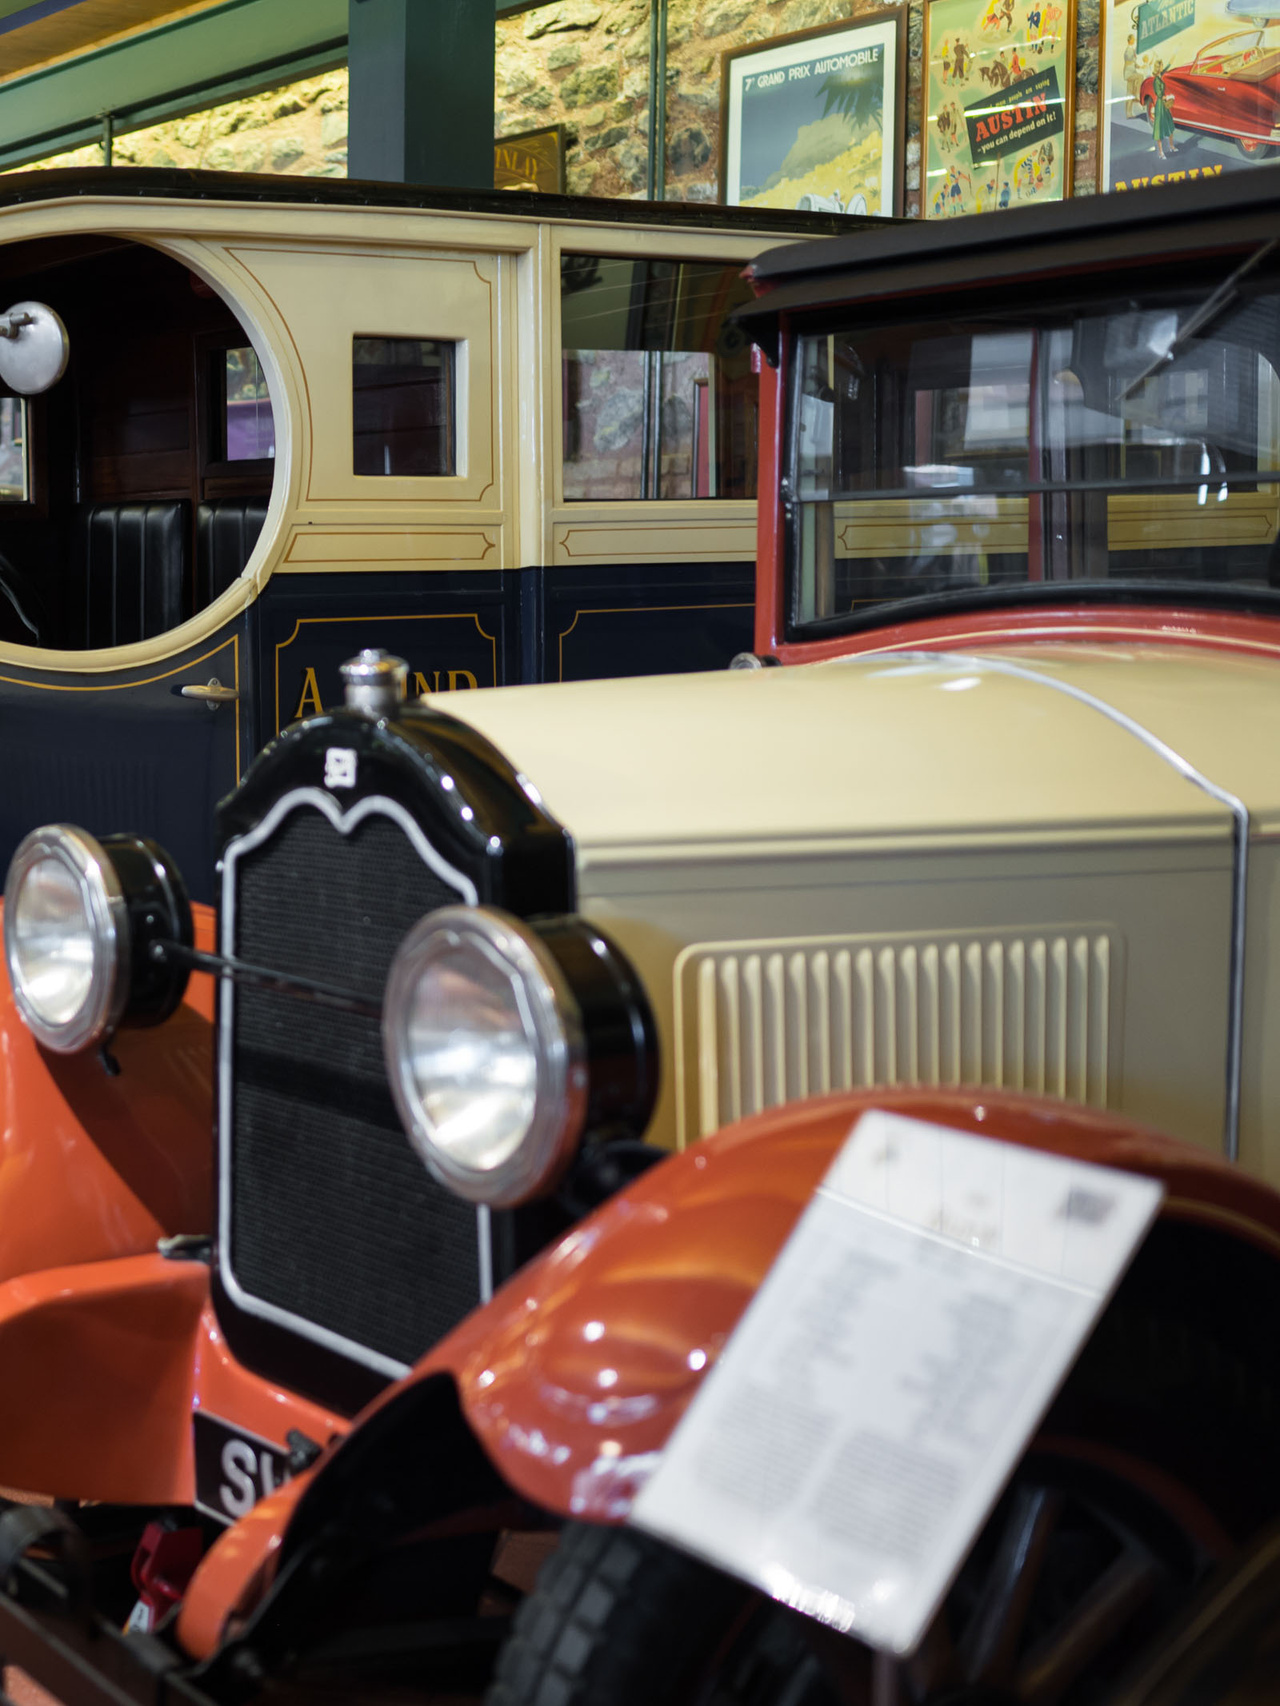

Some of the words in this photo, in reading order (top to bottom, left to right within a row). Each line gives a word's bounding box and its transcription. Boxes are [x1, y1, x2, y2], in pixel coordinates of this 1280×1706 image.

[1140, 0, 1194, 40] ATLANTIC
[757, 70, 785, 88] GRAND
[788, 64, 811, 81] PRIX
[814, 48, 878, 75] AUTOMOBILE
[975, 92, 1047, 142] AUSTIN
[995, 135, 1008, 146] can
[1009, 120, 1036, 140] depend
[1036, 117, 1046, 128] on
